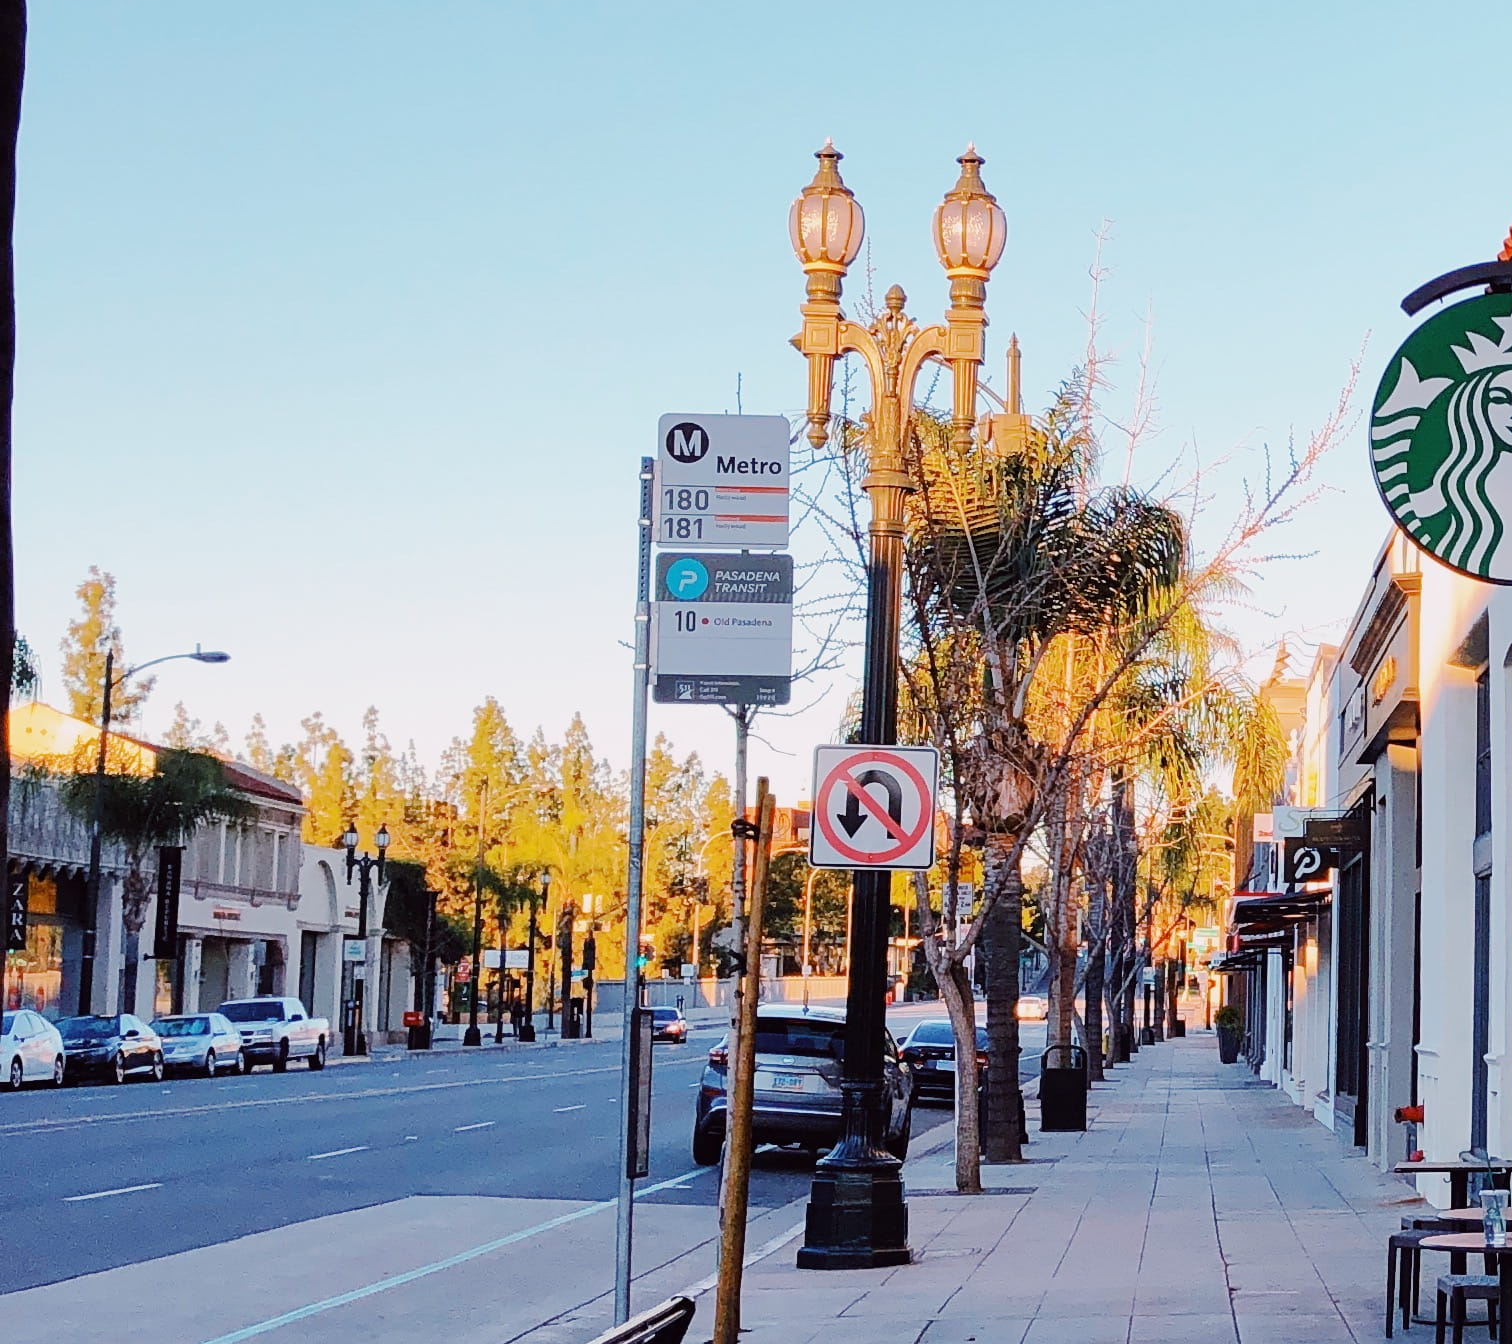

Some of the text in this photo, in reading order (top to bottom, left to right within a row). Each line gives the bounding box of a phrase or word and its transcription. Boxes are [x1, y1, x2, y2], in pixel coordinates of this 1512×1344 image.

[716, 455, 782, 475] Metro
[664, 488, 709, 510] 180
[663, 517, 703, 539] 181
[715, 570, 781, 582] PASADENA
[715, 583, 767, 593] TRANSIT
[674, 610, 696, 632] 10
[713, 617, 772, 627] Old Pasadena
[10, 883, 24, 941] ZARA
